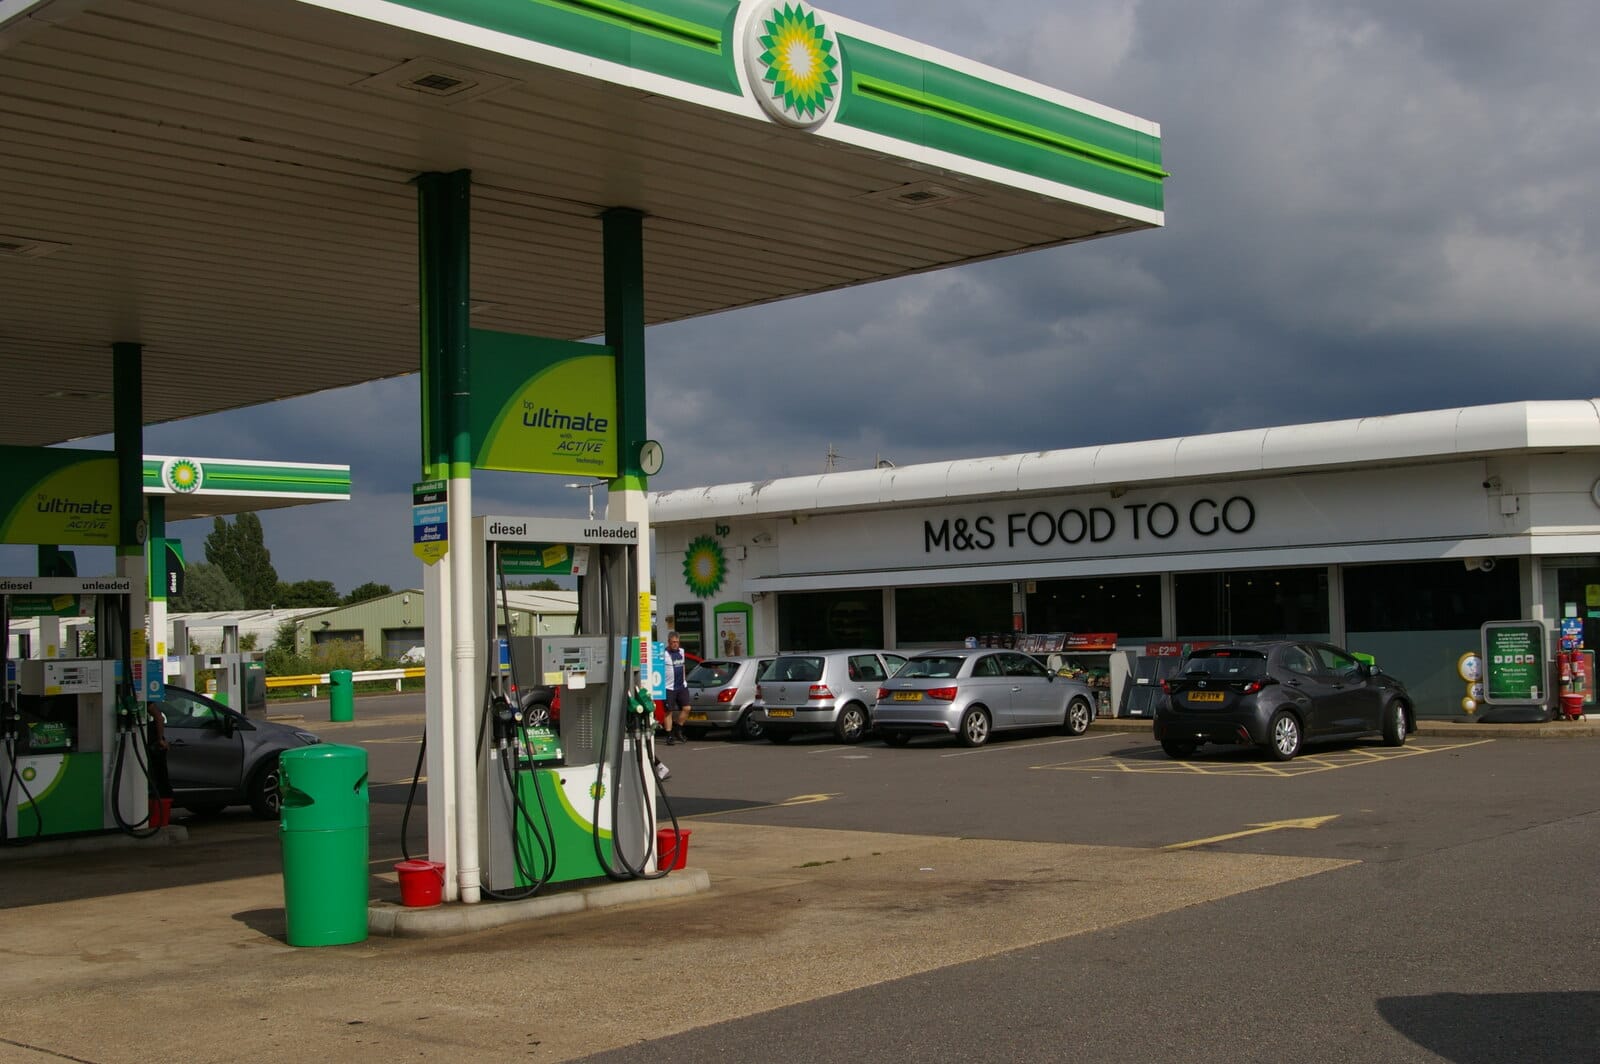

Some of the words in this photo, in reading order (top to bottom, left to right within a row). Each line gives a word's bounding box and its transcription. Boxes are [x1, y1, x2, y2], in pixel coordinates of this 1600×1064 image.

[523, 408, 608, 433] ultimate
[557, 441, 604, 453] ACTIVE
[647, 449, 653, 466] 1
[37, 498, 112, 514] ultimate
[68, 520, 107, 529] ACTIVE
[489, 522, 527, 536] diesel
[584, 526, 637, 539] unleaded
[715, 523, 730, 538] bp
[924, 515, 995, 552] M&S
[1007, 507, 1116, 547] FOOD
[1123, 502, 1179, 539] TO
[1189, 496, 1256, 535] GO
[0, 581, 32, 590] diesel
[82, 581, 130, 590] unleaded
